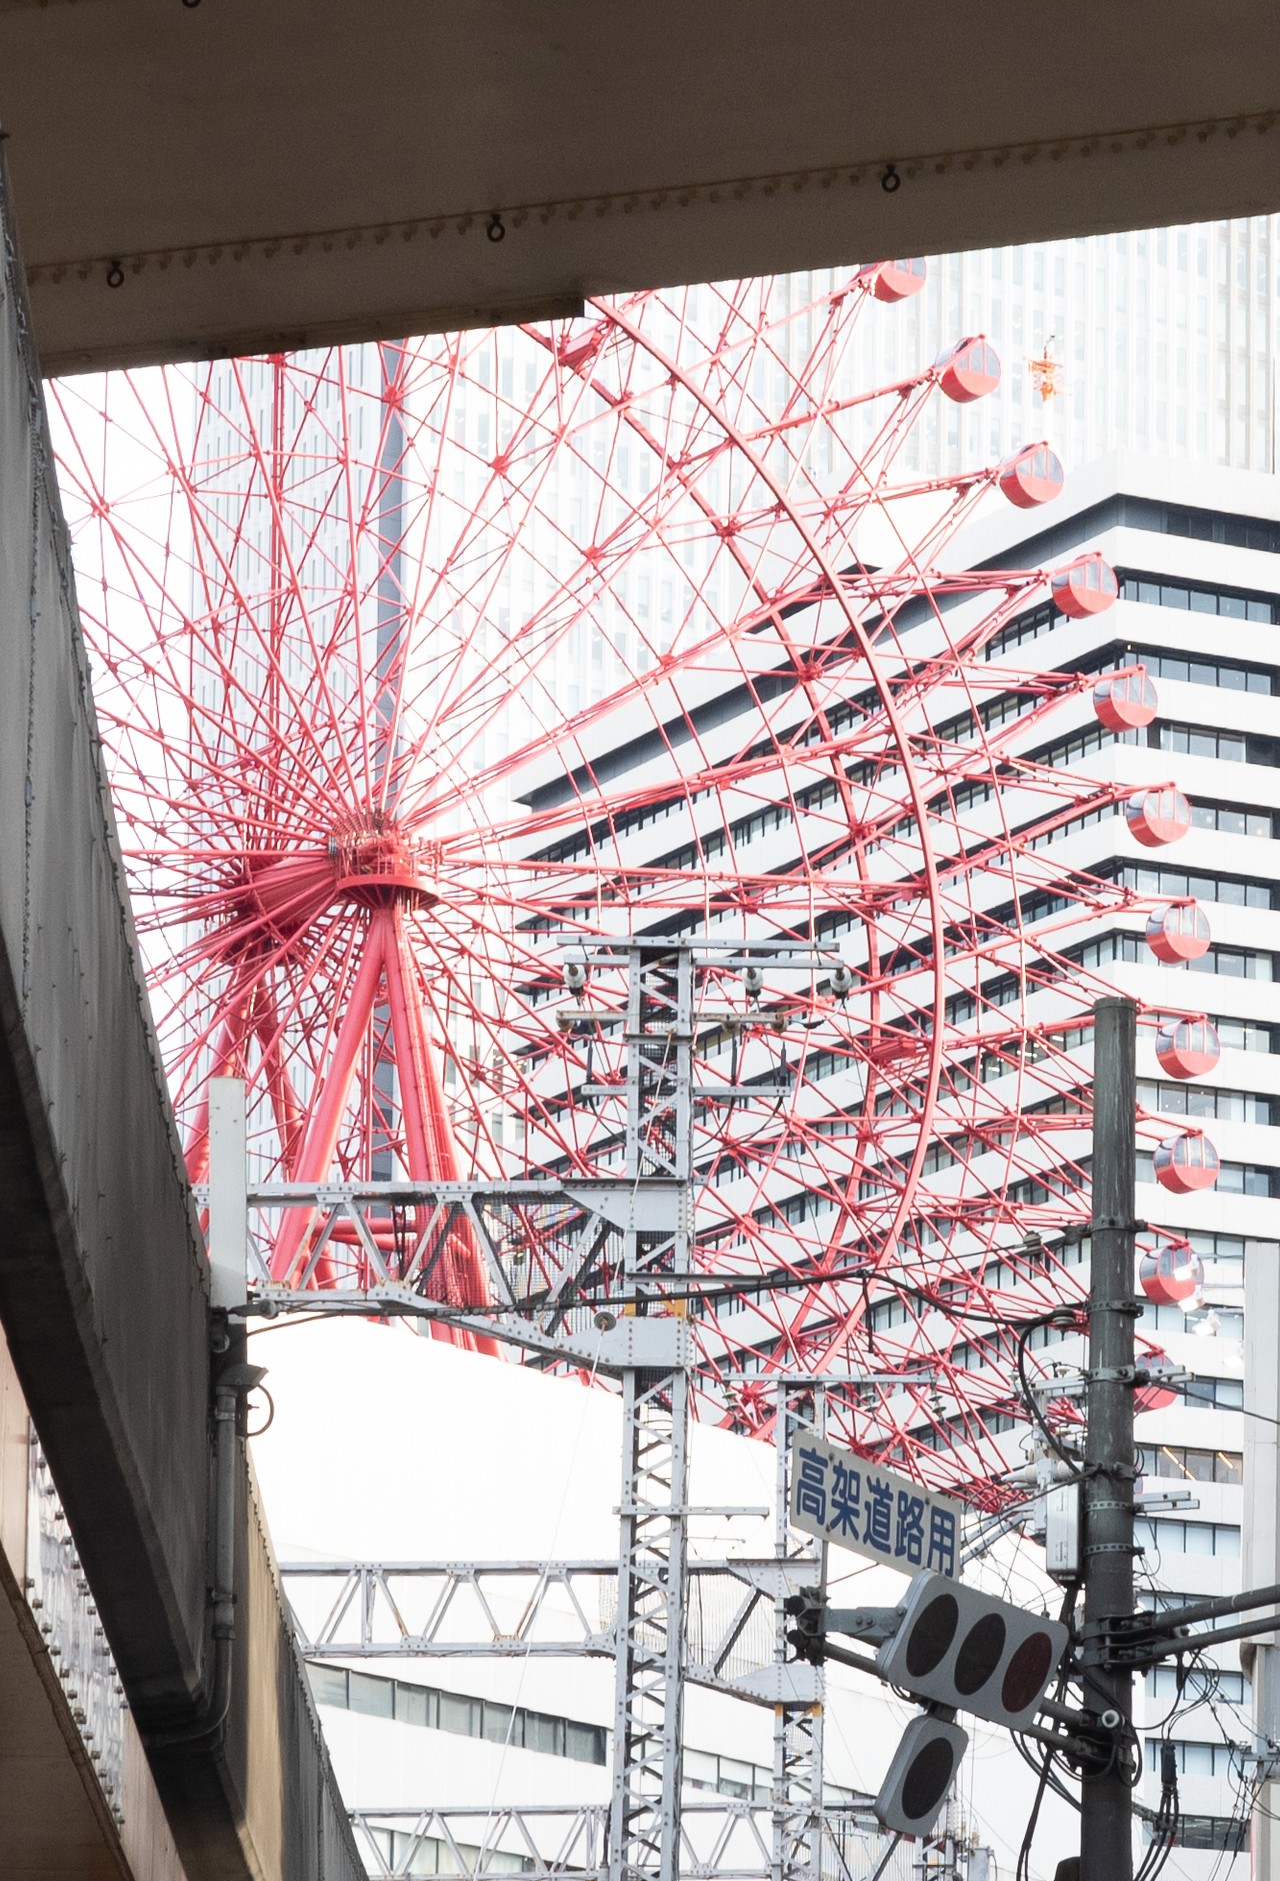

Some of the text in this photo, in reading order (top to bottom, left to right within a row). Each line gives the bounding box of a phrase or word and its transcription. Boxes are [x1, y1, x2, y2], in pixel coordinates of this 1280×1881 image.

[796, 1447, 956, 1578] 高架道路用
